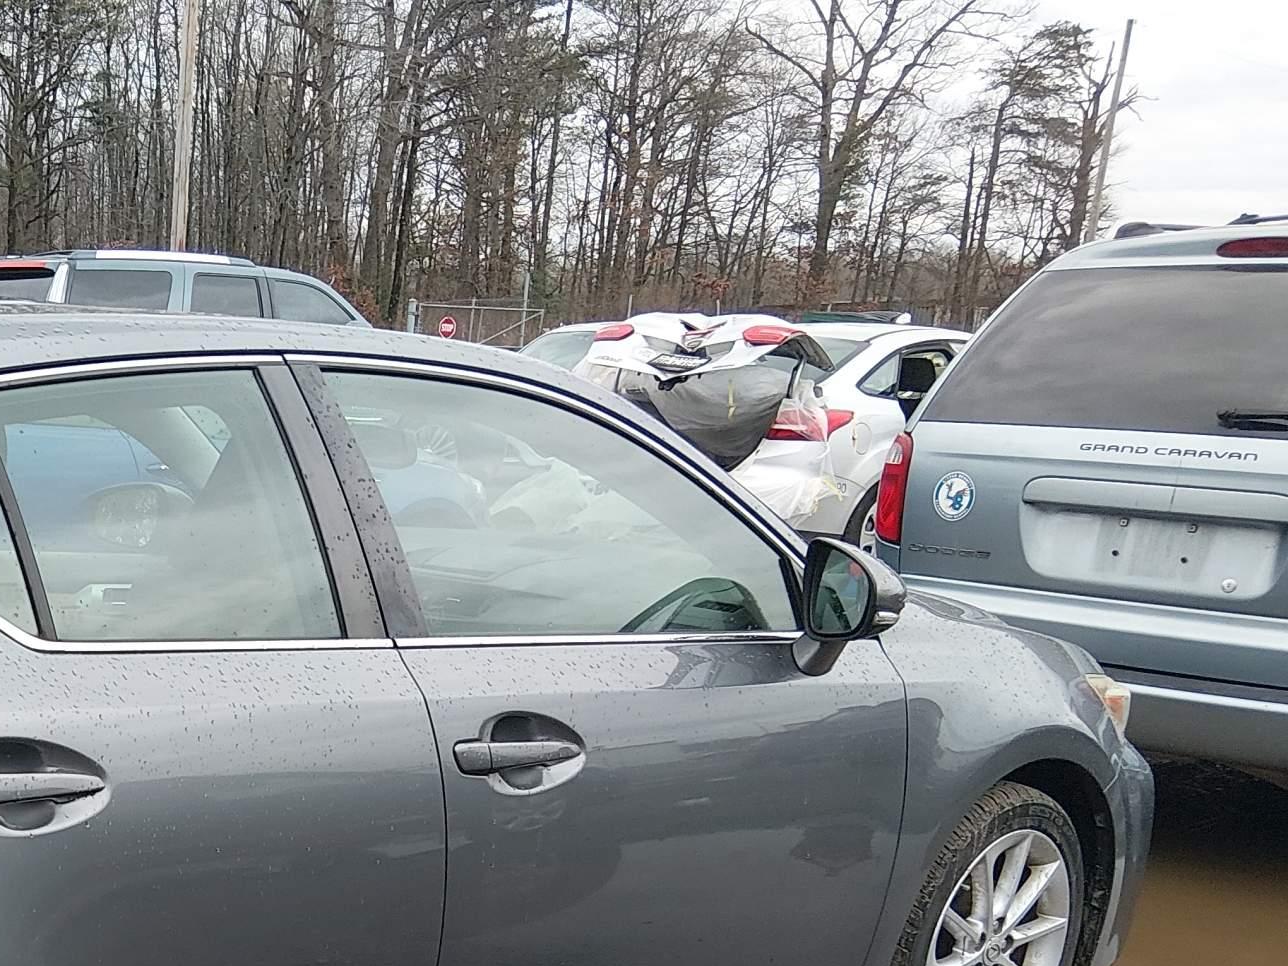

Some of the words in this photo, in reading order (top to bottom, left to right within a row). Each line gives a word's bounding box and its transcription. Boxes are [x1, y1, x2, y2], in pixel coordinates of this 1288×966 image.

[441, 323, 454, 332] STOP
[1079, 442, 1148, 455] GRAND
[1154, 446, 1258, 462] CARAVAN
[908, 543, 992, 560] DODGE
